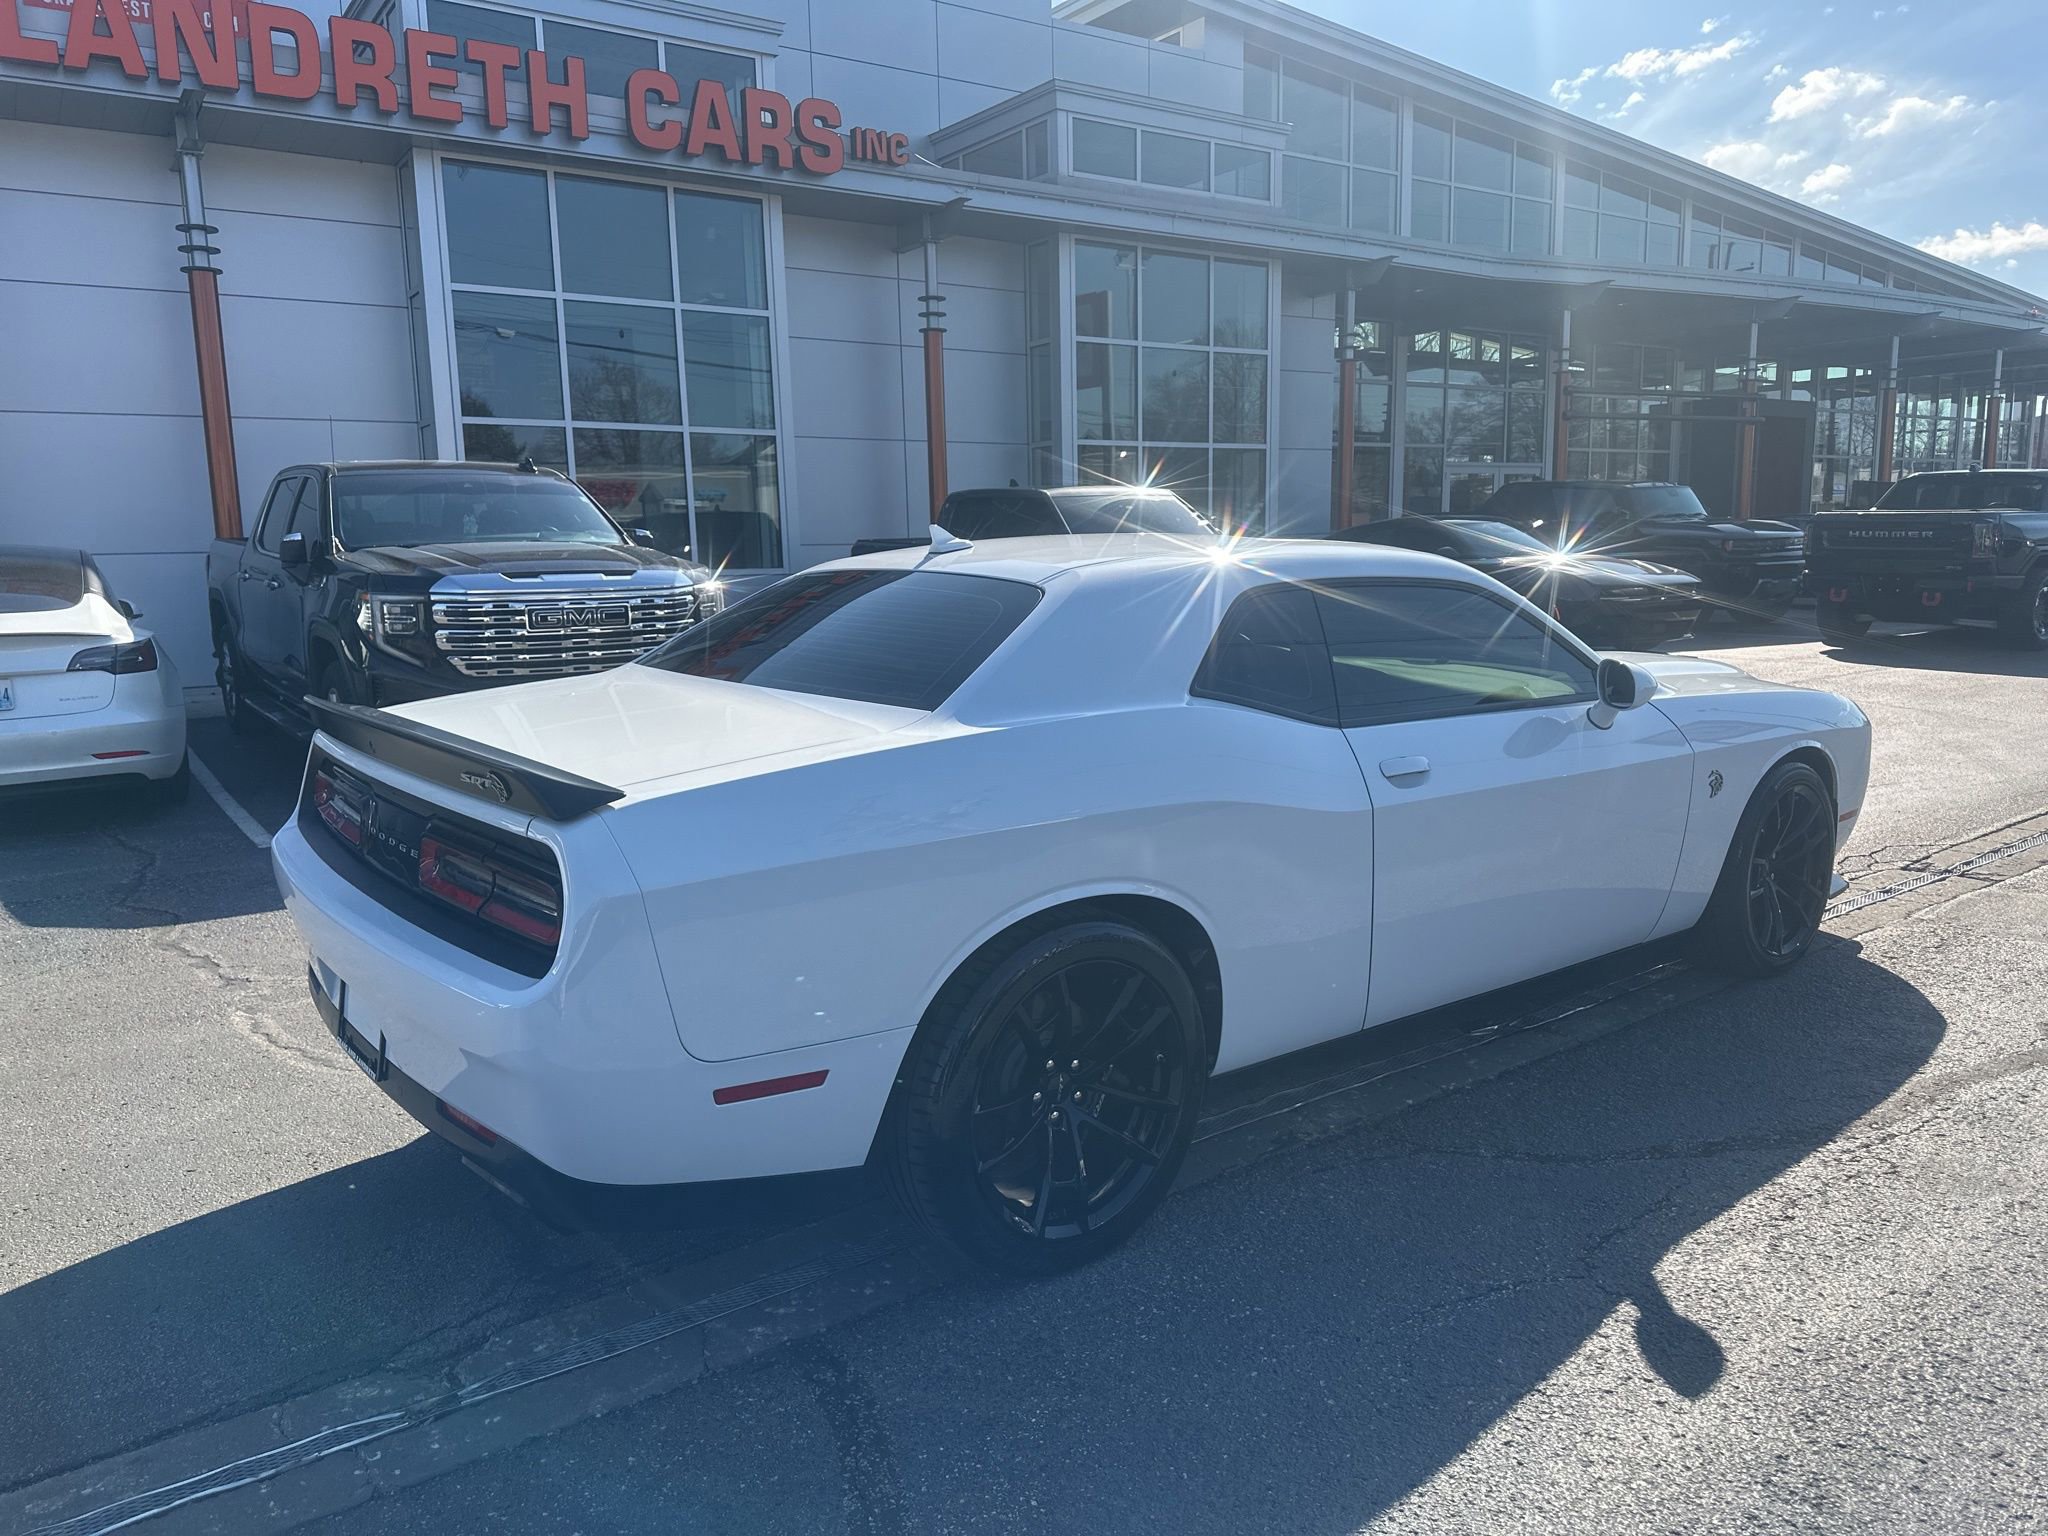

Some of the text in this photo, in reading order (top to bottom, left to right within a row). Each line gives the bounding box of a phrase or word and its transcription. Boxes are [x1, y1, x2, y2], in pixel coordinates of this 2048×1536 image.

[0, 0, 910, 175] LANDRETH CARS INC
[1849, 530, 1934, 539] HUMMER
[532, 607, 626, 628] GMC
[460, 772, 492, 790] SRT
[370, 827, 419, 859] DODGE
